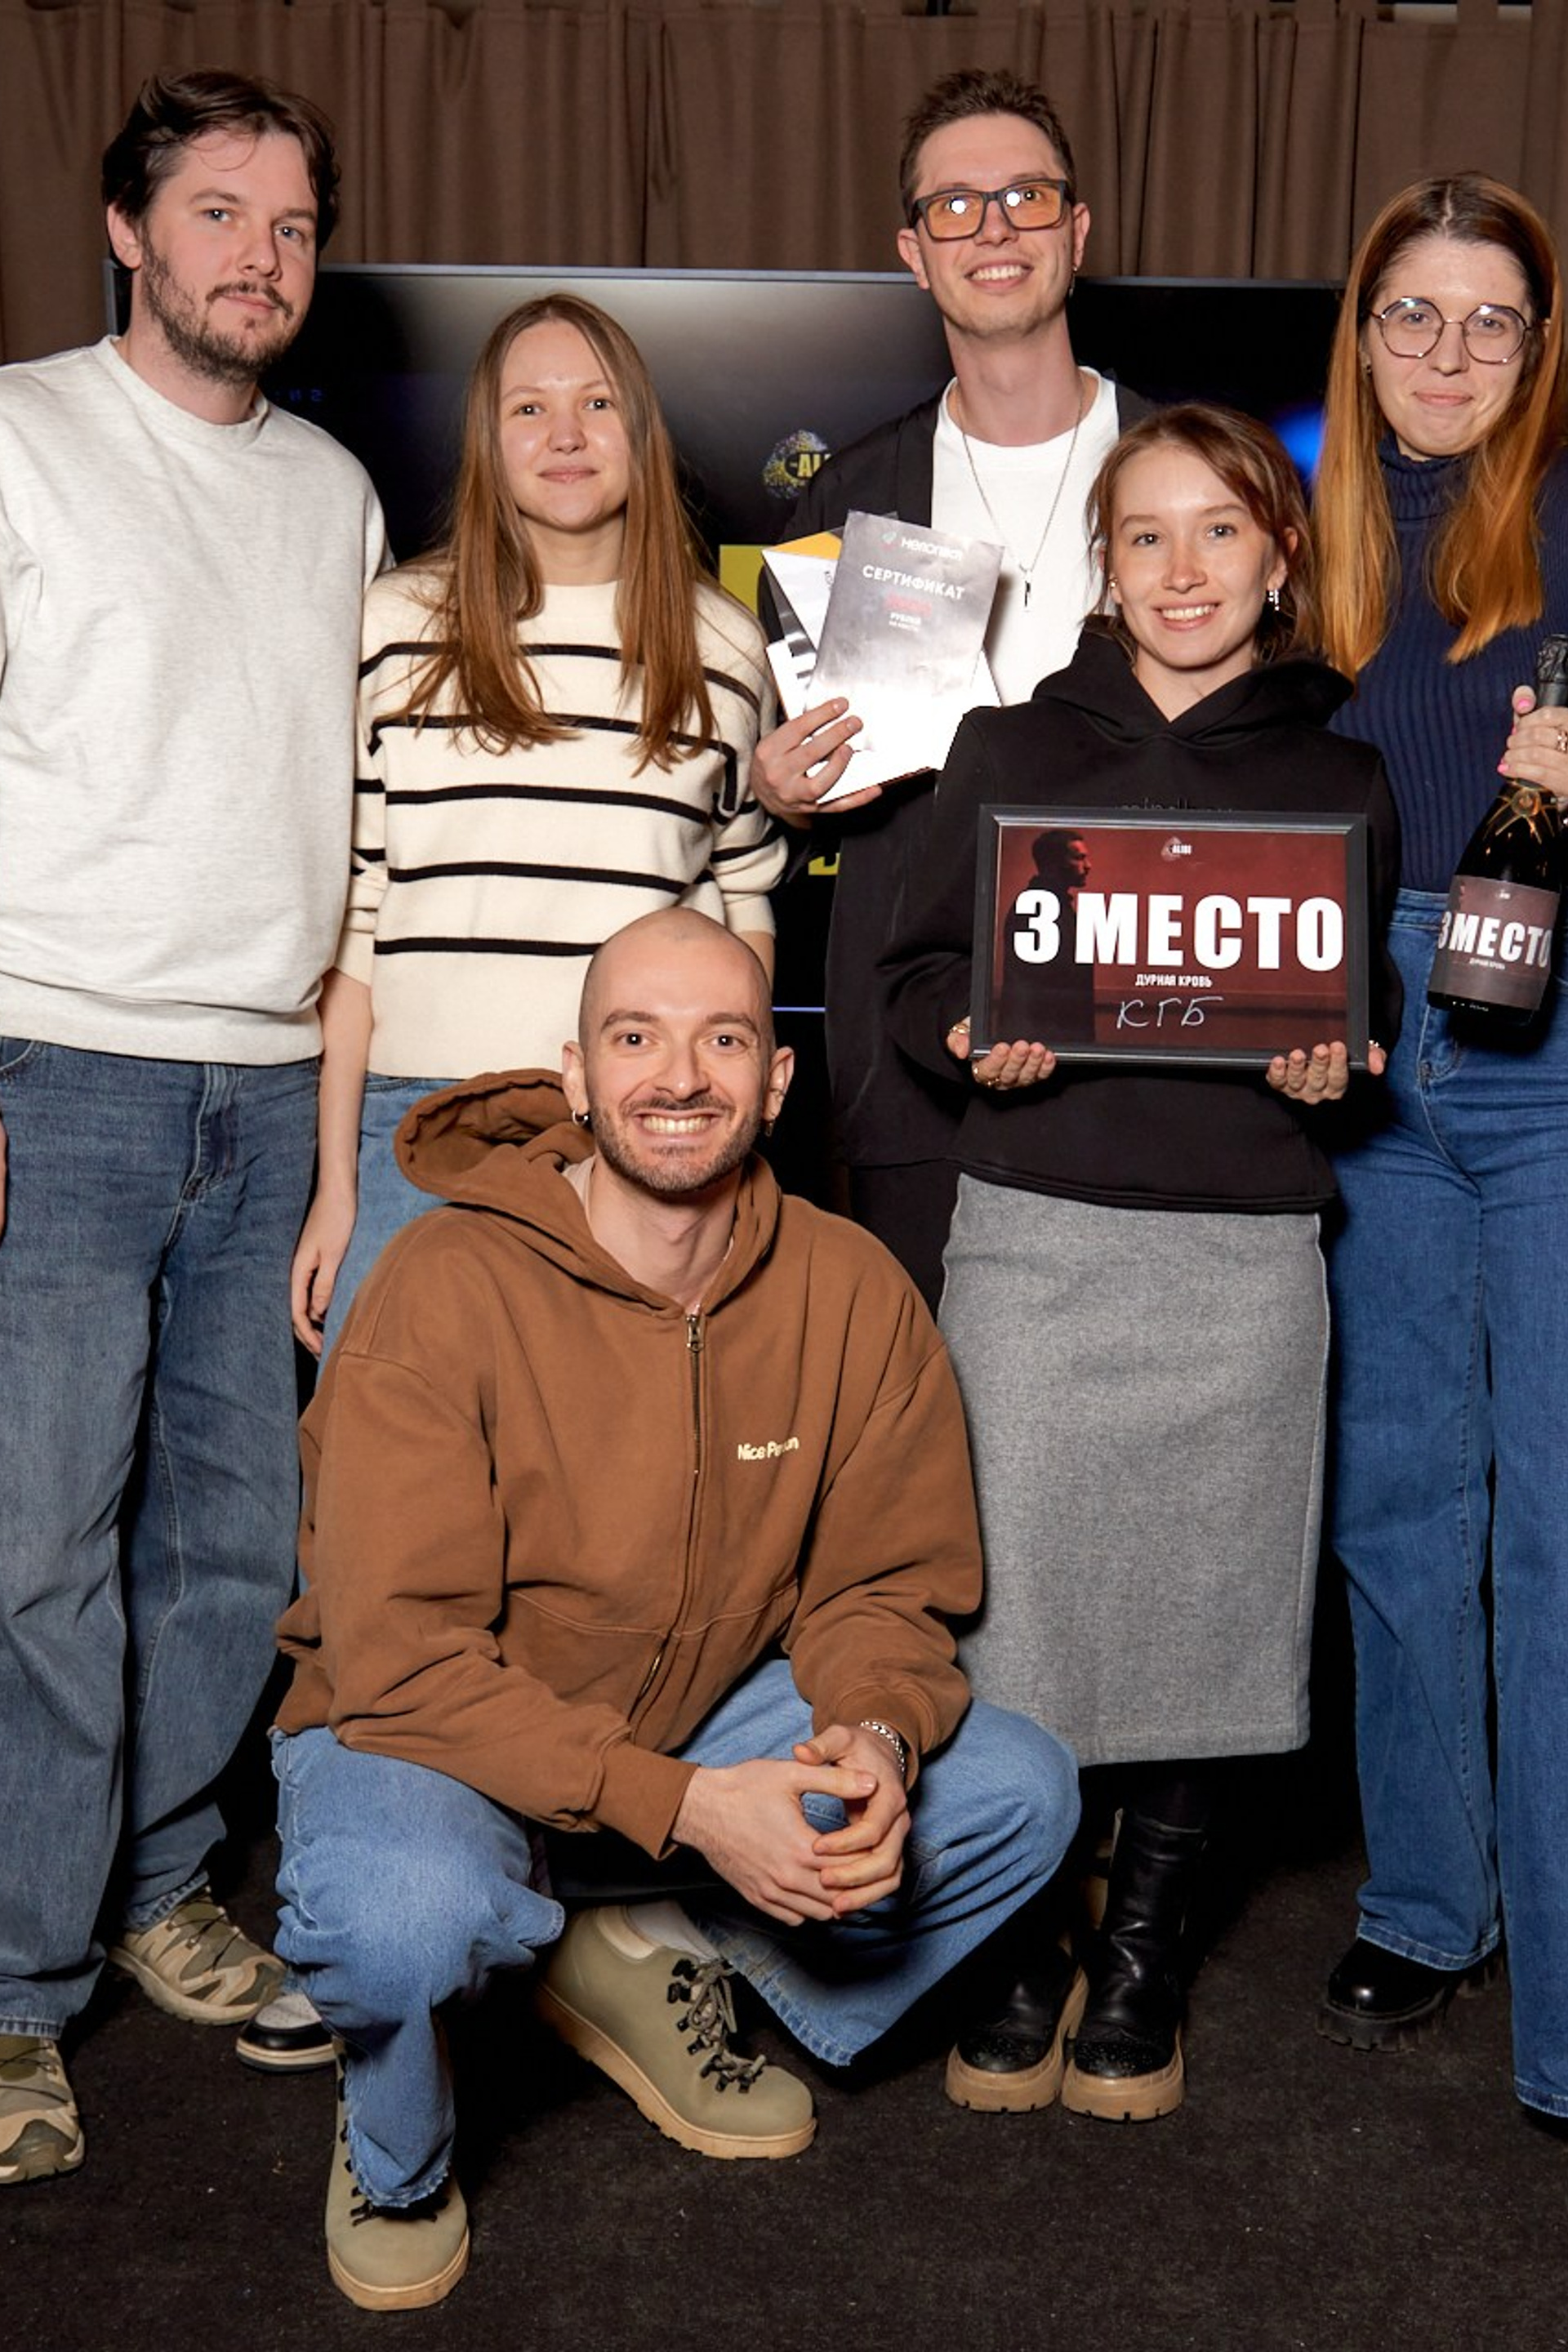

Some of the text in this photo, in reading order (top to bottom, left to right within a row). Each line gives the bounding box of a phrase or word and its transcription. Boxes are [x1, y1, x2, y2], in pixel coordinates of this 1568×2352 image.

[862, 564, 965, 599] СЕРТИФИКАТ
[1013, 889, 1344, 972] 3 МЕСТО
[1437, 911, 1553, 969] 3 МЕСТО
[1135, 973, 1213, 987] ДУРНАЯ КРОВЬ
[1116, 996, 1223, 1029] КГБ
[737, 1442, 765, 1460] Nice
